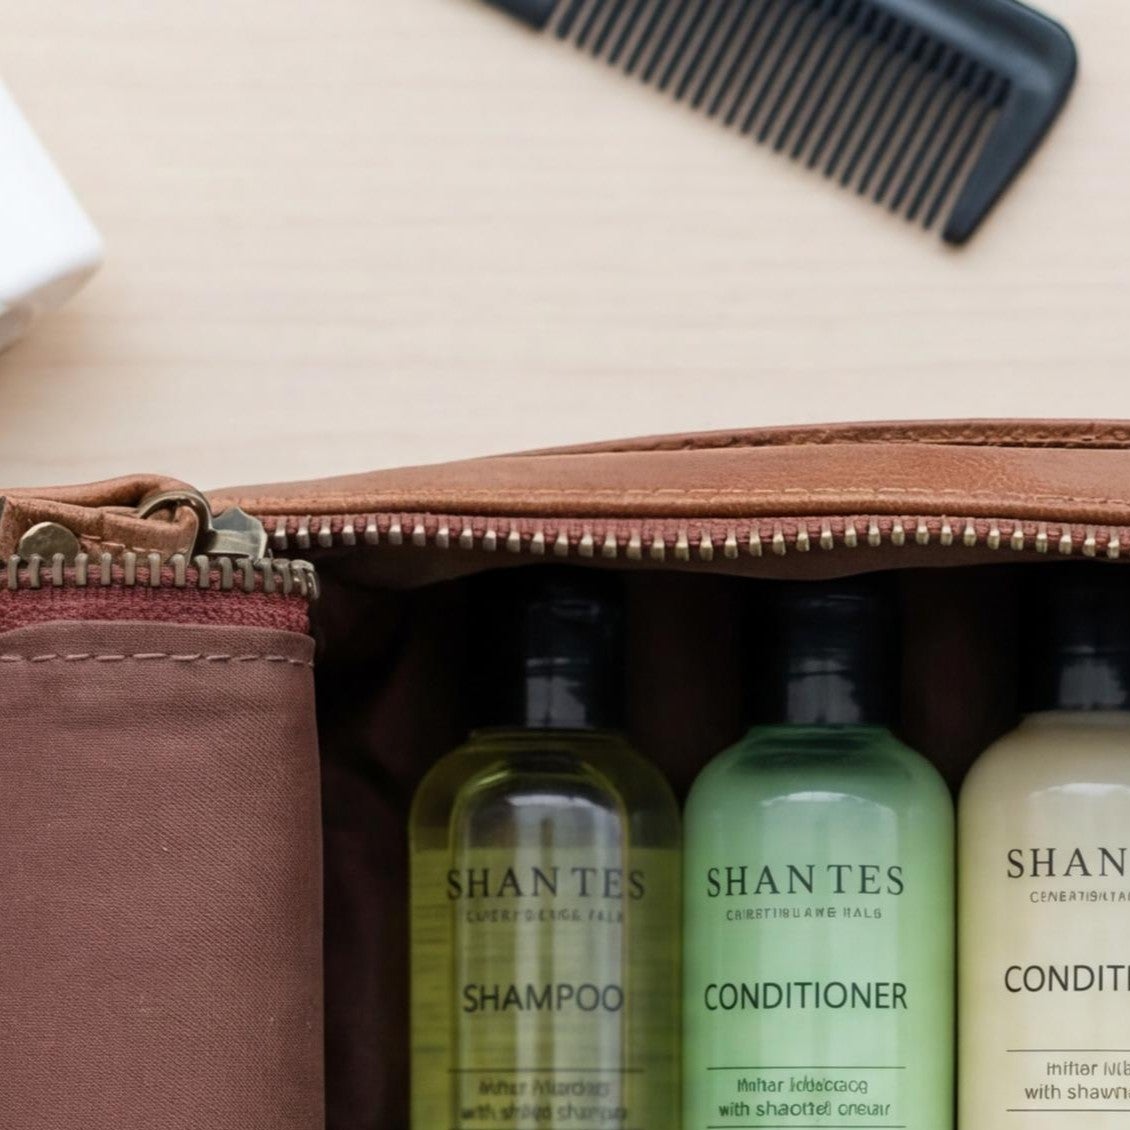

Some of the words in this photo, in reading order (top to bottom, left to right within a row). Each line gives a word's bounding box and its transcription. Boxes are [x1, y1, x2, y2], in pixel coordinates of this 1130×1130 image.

[463, 983, 625, 1013] SHAMPOO
[704, 981, 908, 1011] CONDITIONER
[1025, 1083, 1061, 1100] with
[719, 1101, 750, 1117] with
